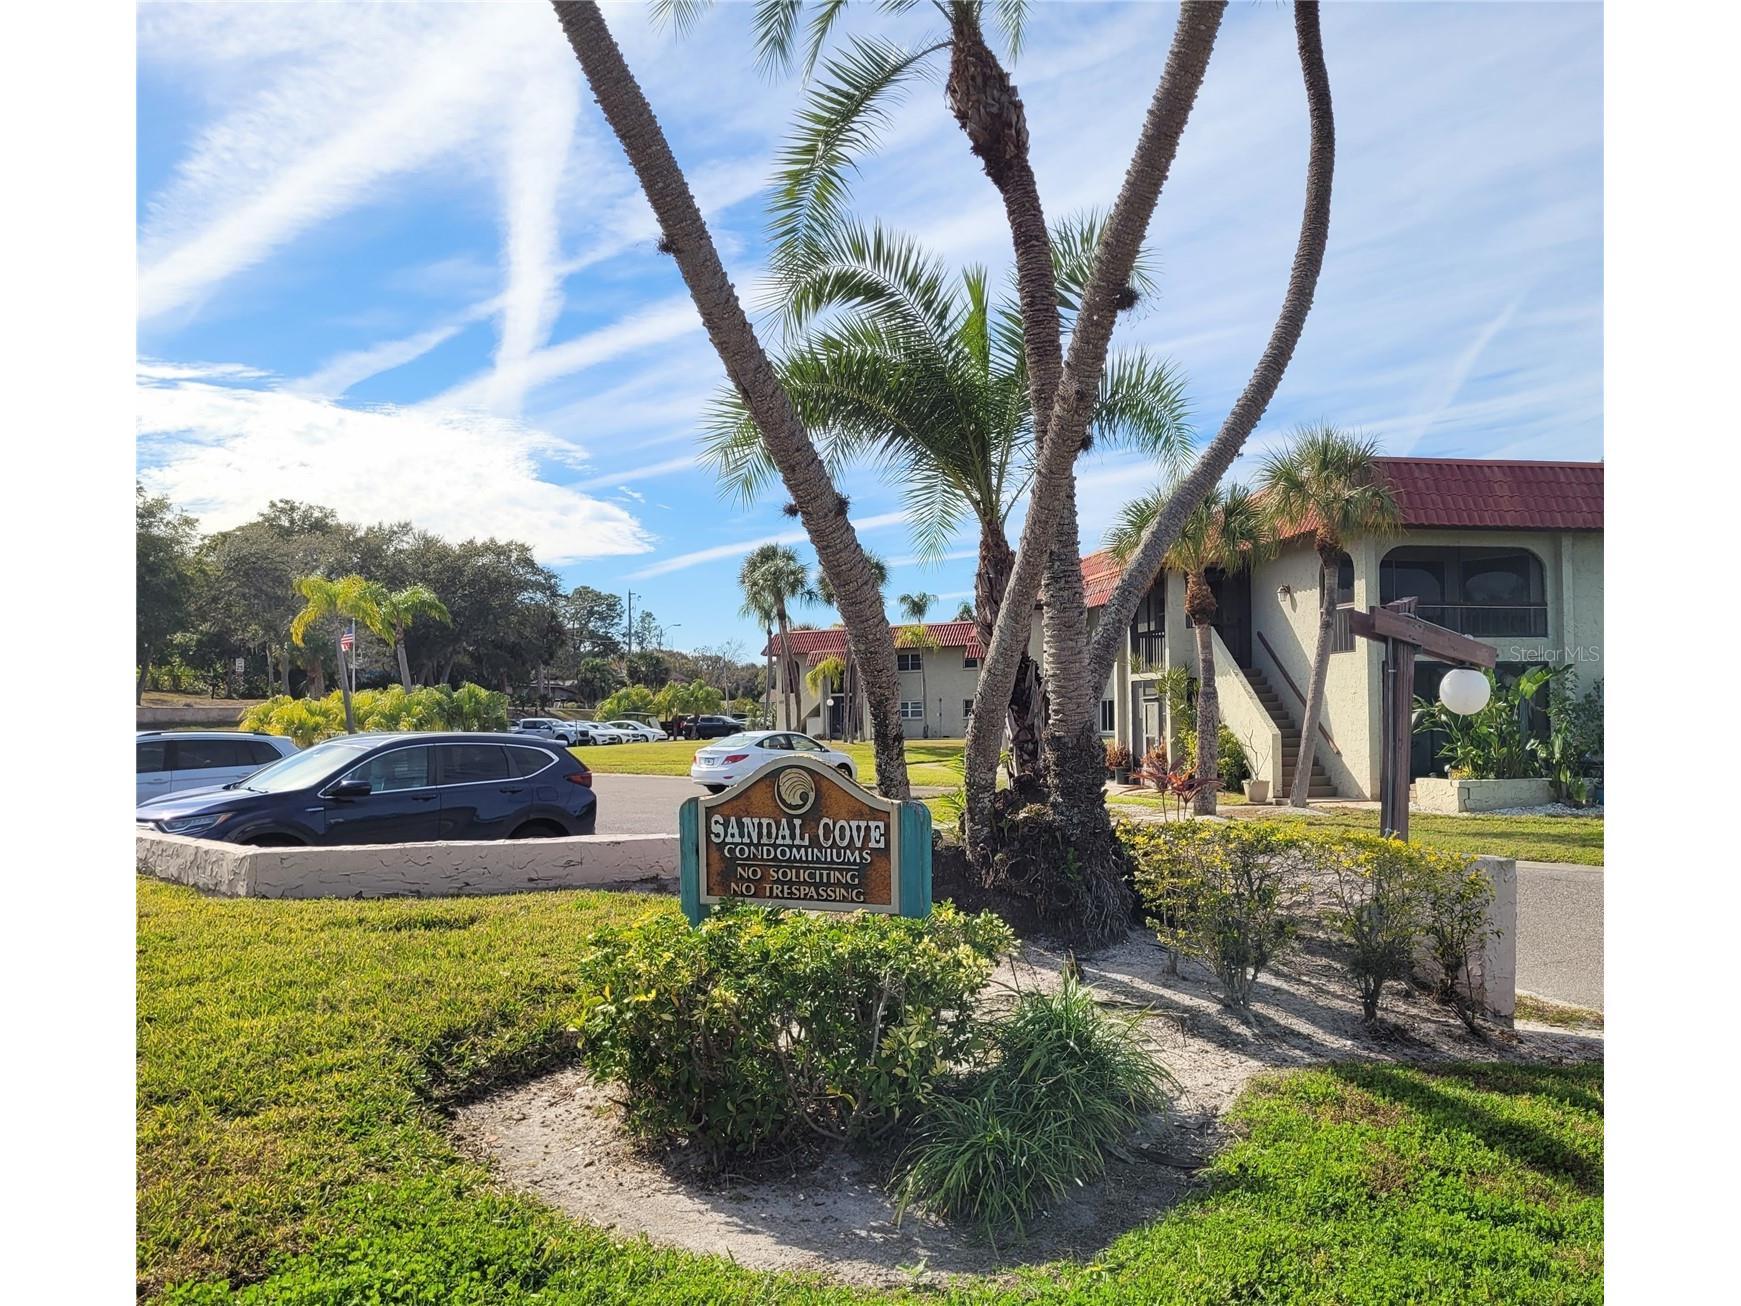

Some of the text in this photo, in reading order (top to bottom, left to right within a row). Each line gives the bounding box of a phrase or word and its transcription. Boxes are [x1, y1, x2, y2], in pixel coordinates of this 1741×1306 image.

[710, 814, 885, 849] SANDAL COVE
[724, 845, 871, 863] CONDOMINIUMS
[736, 866, 860, 885] NO SOLICITING
[730, 882, 865, 902] NO TRESPASSING
